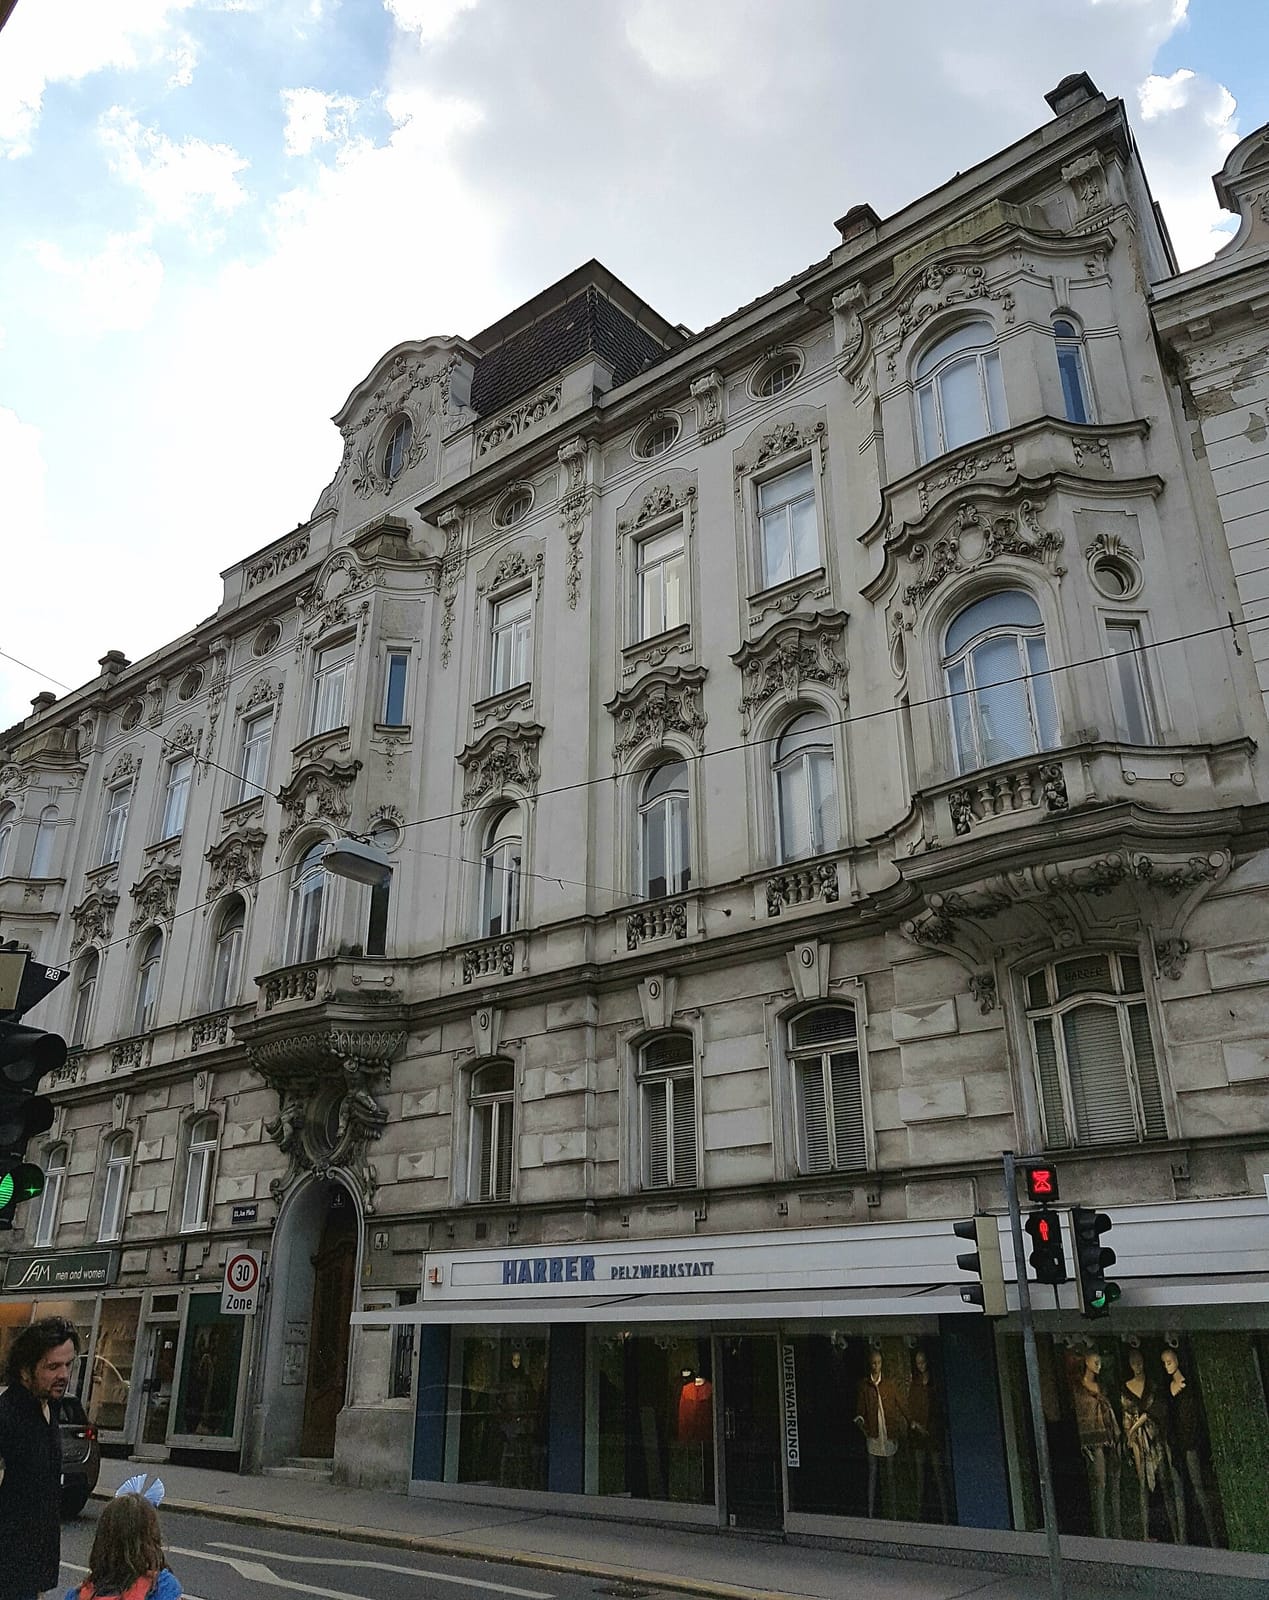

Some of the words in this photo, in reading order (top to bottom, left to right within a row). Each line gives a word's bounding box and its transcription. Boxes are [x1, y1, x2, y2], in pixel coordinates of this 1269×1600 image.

[46, 968, 60, 980] 28
[70, 1265, 83, 1280] and
[236, 1264, 250, 1282] 30
[502, 1255, 595, 1285] HARRER
[610, 1261, 715, 1280] PELZWERKSTATT
[226, 1294, 253, 1310] Zone
[783, 1345, 799, 1460] AUFBEWAHRUNG
